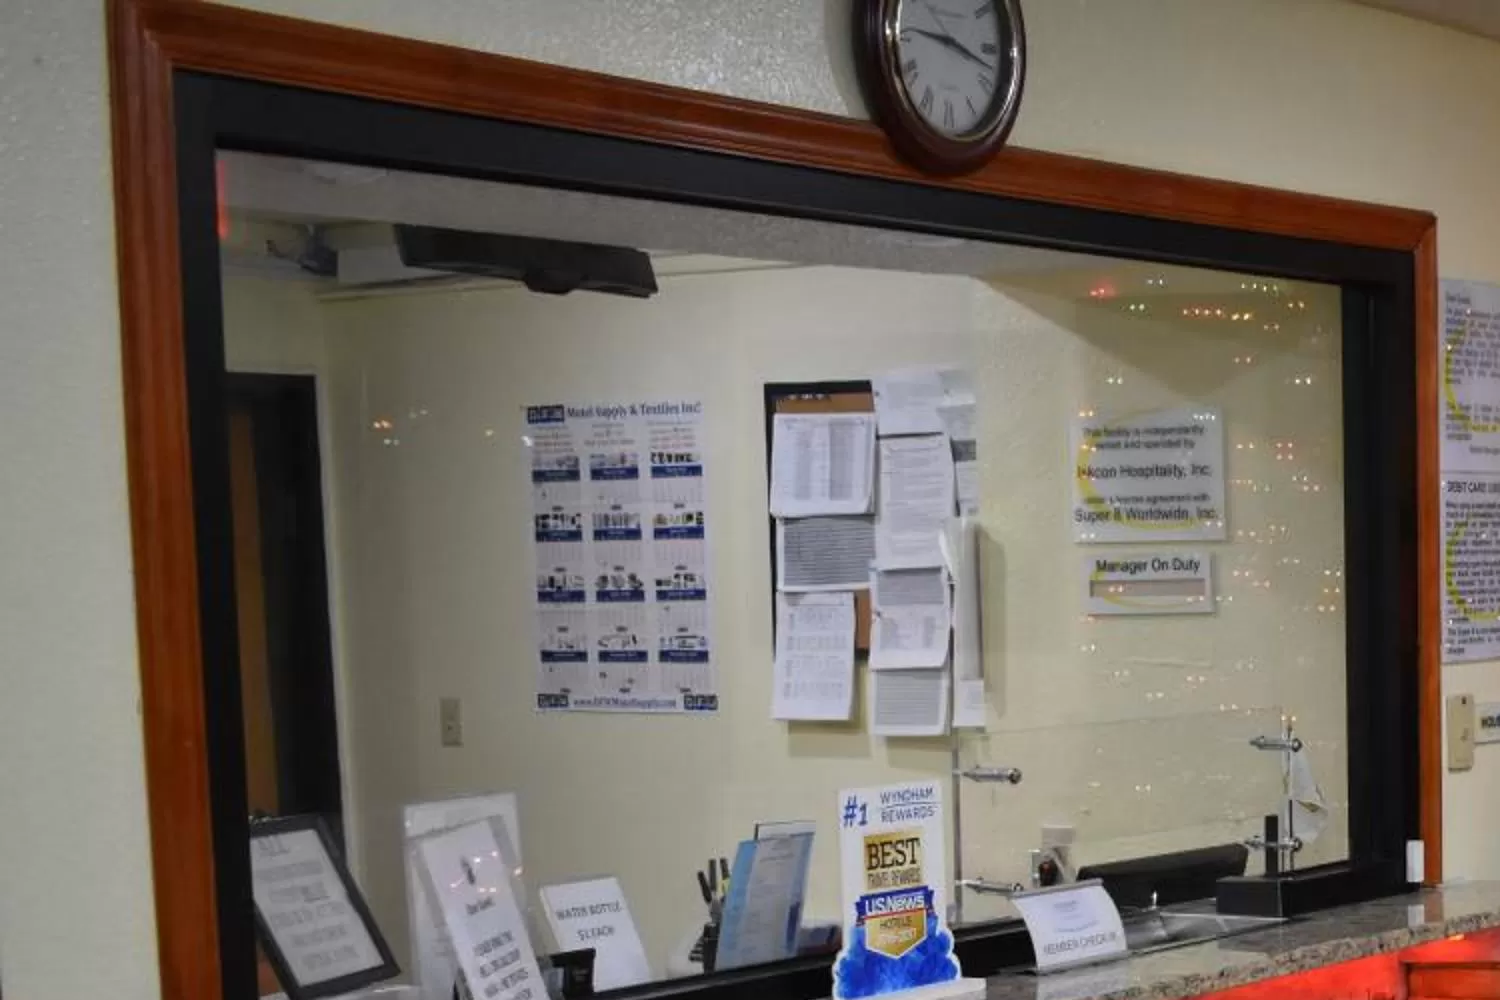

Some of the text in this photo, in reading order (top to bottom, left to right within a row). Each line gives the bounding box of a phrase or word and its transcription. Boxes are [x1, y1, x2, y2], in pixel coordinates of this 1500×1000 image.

[1096, 556, 1200, 575] Manager On Duty
[843, 787, 933, 827] #1 WYNDHAM
[881, 804, 935, 823] REWARDS
[867, 837, 920, 871] BEST
